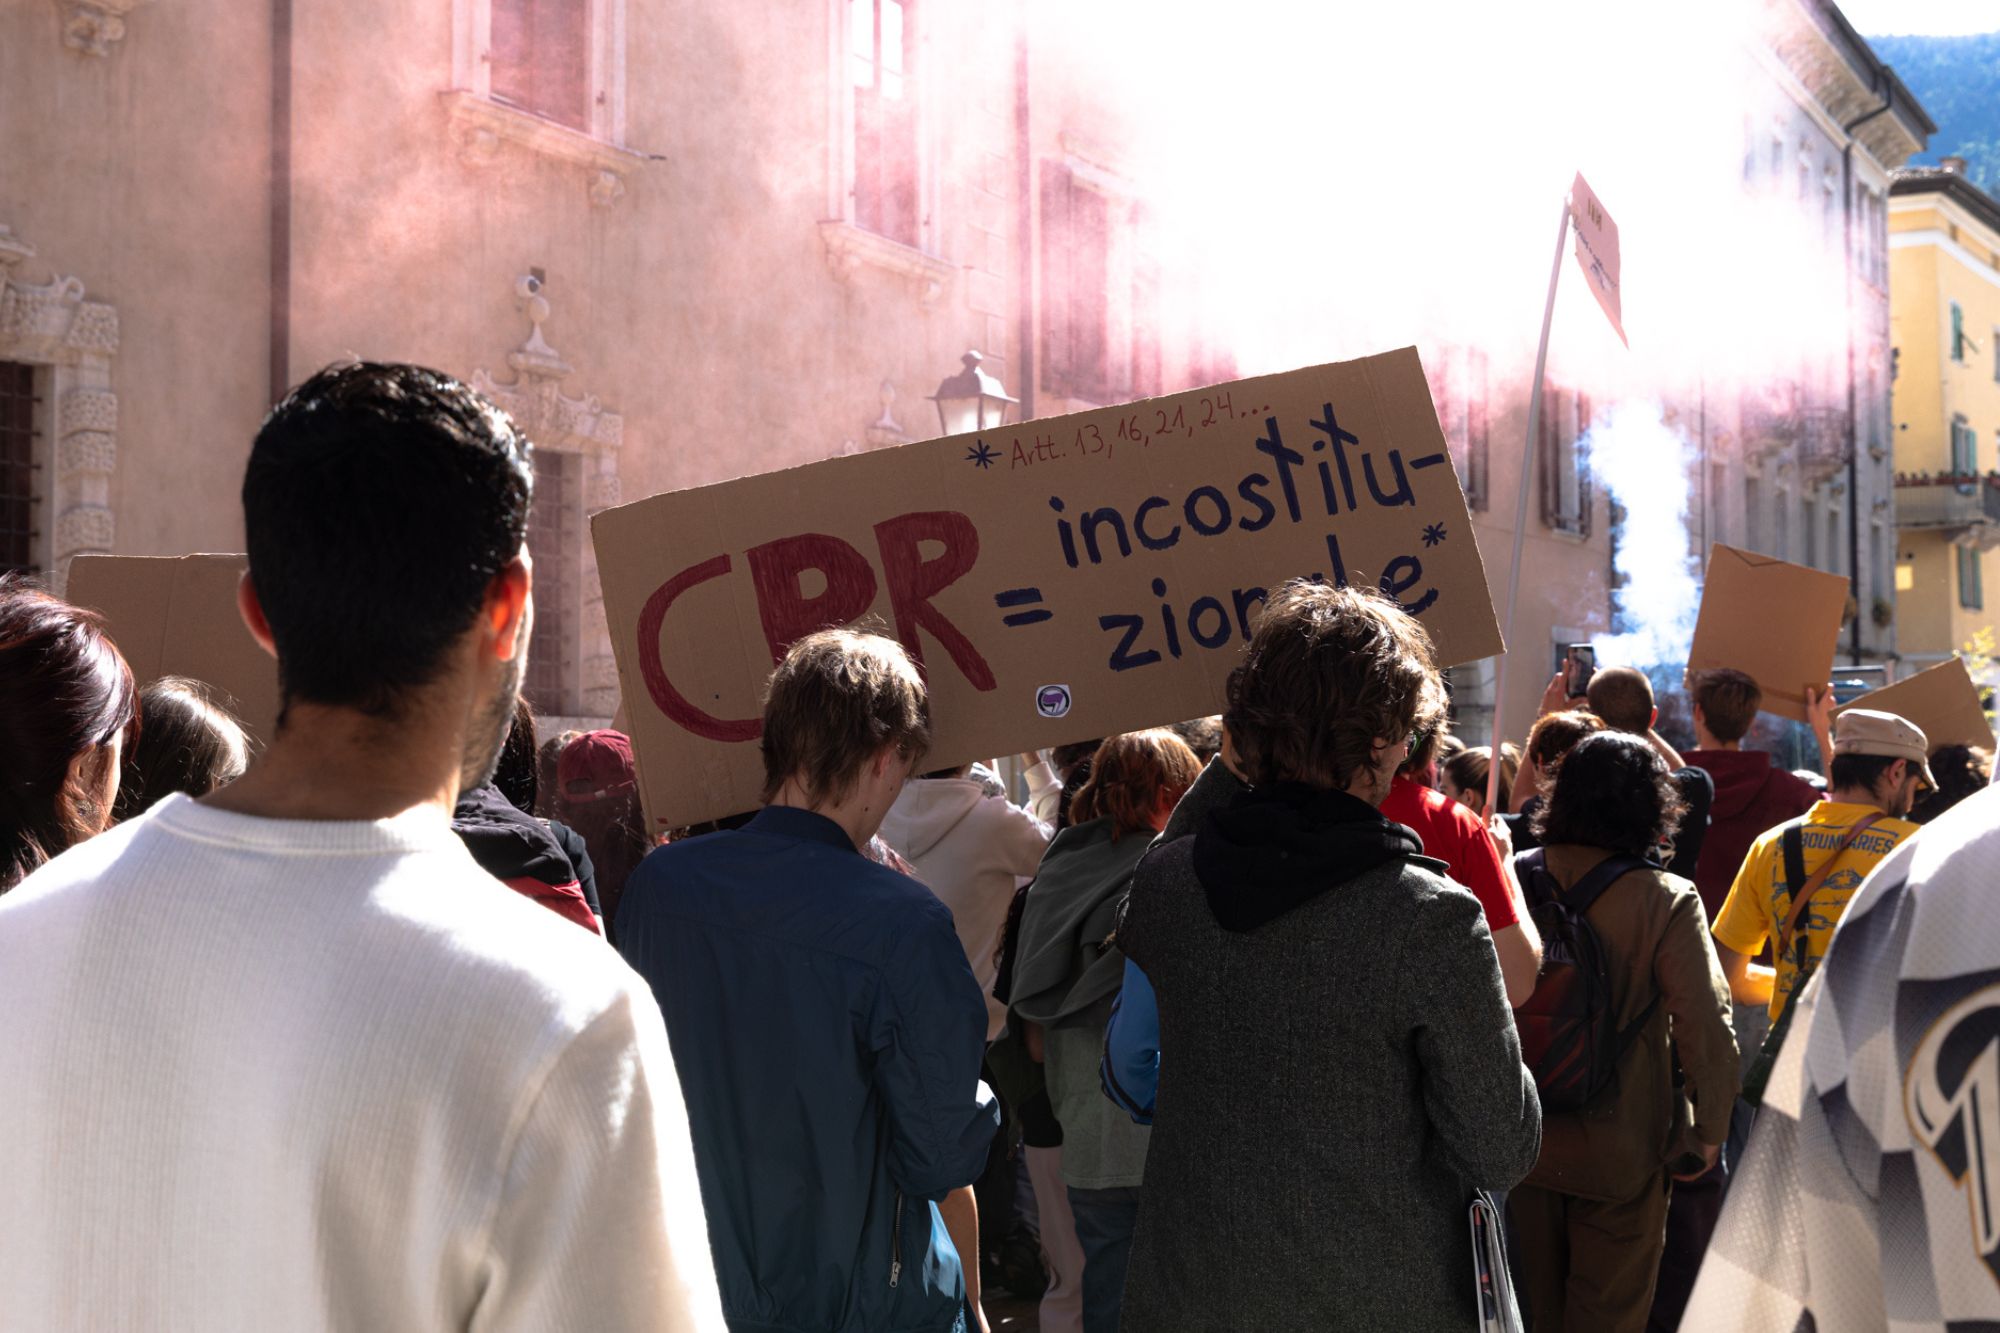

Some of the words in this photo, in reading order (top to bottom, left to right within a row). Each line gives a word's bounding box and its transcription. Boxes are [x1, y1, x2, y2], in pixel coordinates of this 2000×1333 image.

[1010, 433, 1068, 470] Artt.
[1074, 424, 1113, 459] 13,
[1118, 414, 1149, 447] 16,
[1155, 405, 1194, 438] 21,
[1200, 391, 1271, 428] 24...
[637, 510, 997, 743] CPR
[1049, 402, 1446, 568] incostitu-
[1099, 521, 1448, 672] zionle
[1802, 832, 1895, 854] BOUNARIES
